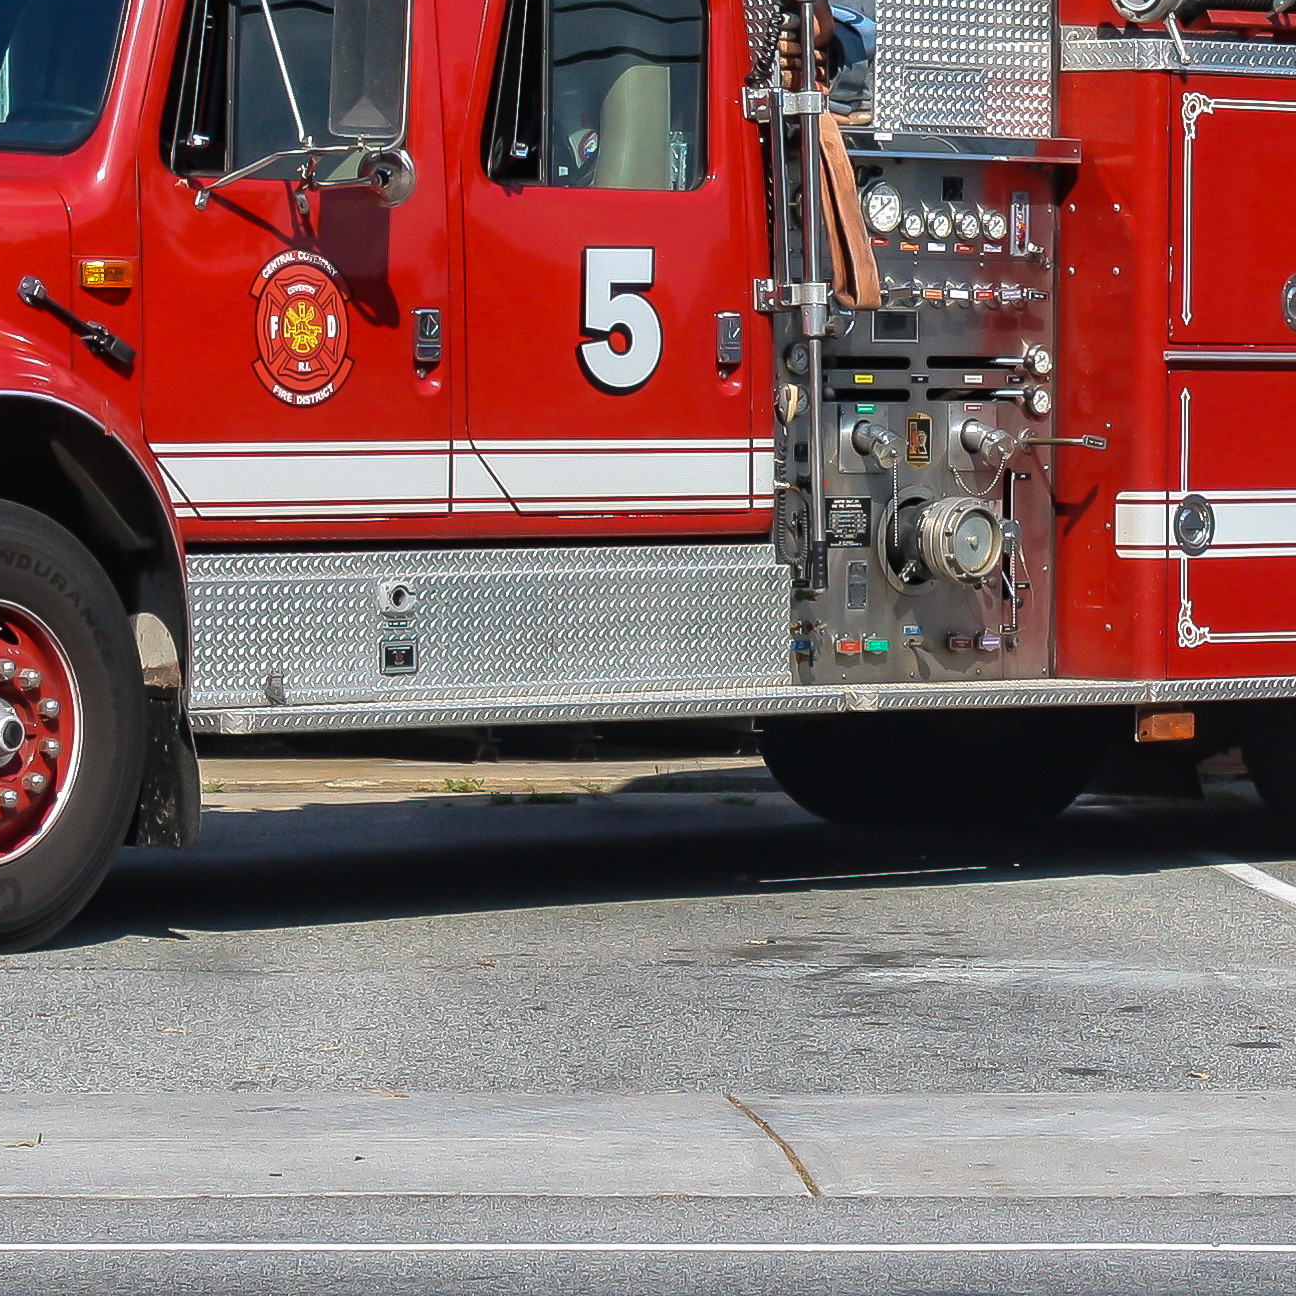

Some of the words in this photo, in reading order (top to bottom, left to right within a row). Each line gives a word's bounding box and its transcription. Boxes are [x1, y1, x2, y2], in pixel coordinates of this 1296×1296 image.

[262, 252, 296, 280] CENTRAL
[269, 314, 281, 340] F
[327, 314, 338, 339] D
[579, 247, 663, 390] 5
[271, 383, 293, 404] FIRE
[295, 382, 336, 405] DISTRICT
